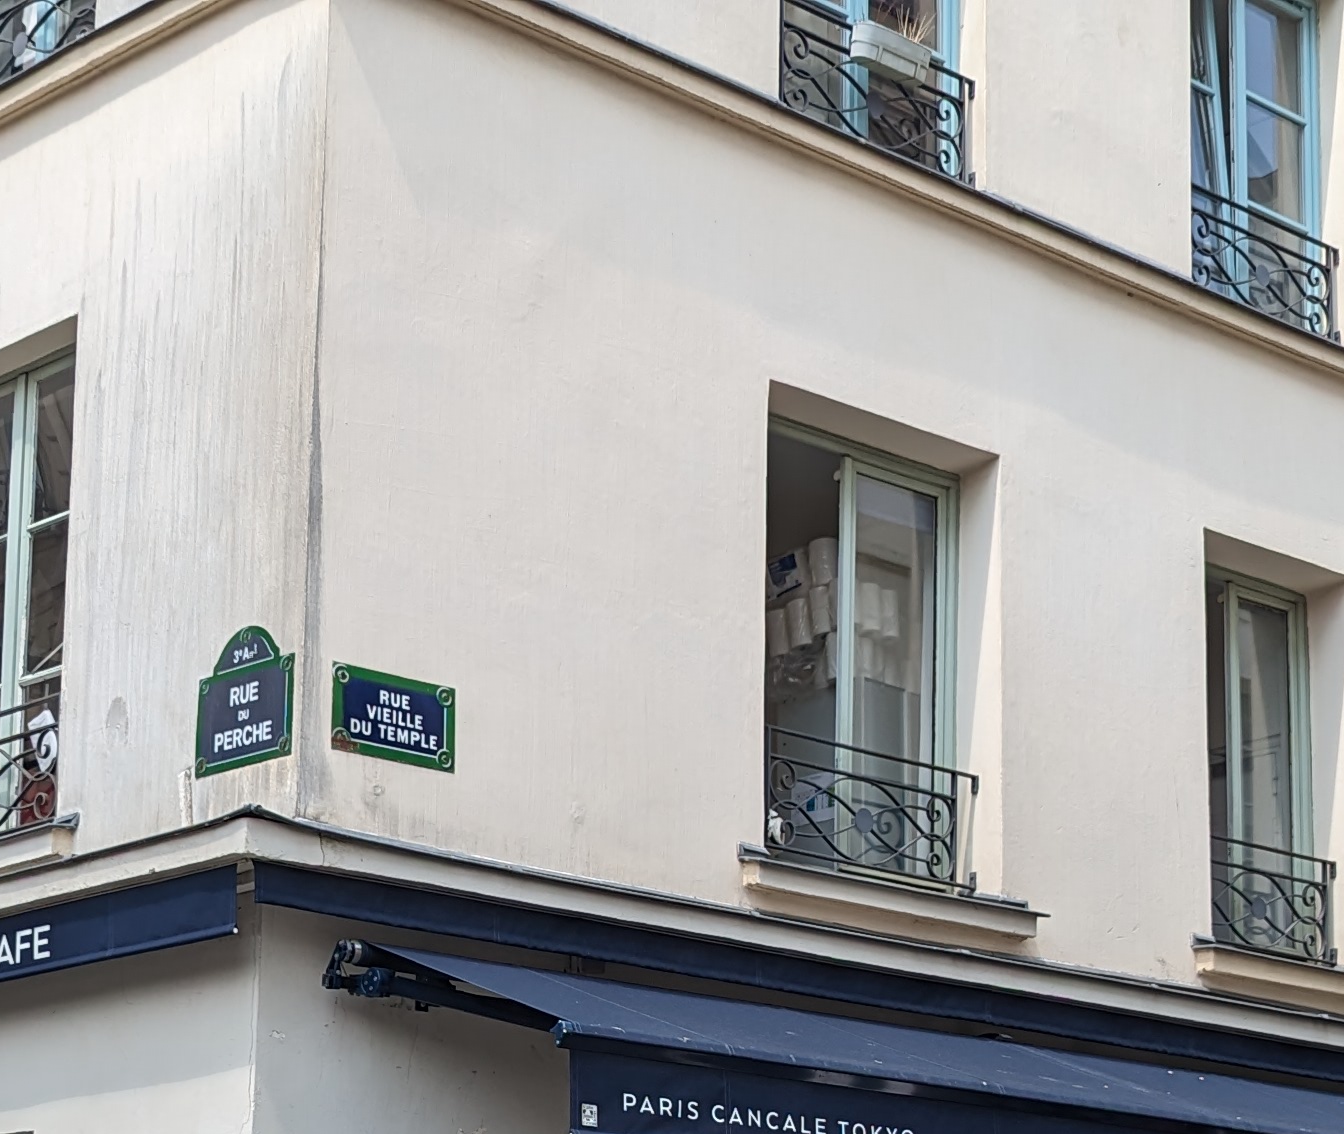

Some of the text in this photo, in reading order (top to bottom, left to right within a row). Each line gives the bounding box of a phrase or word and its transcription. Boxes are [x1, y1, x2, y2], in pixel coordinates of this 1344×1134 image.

[229, 681, 259, 707] RUE
[379, 689, 411, 710] RUE
[238, 708, 250, 721] DU
[366, 704, 423, 730] VIEILLE
[214, 720, 272, 752] PERCHE
[350, 718, 438, 750] DU TEMPLE
[622, 1093, 699, 1120] PARIS
